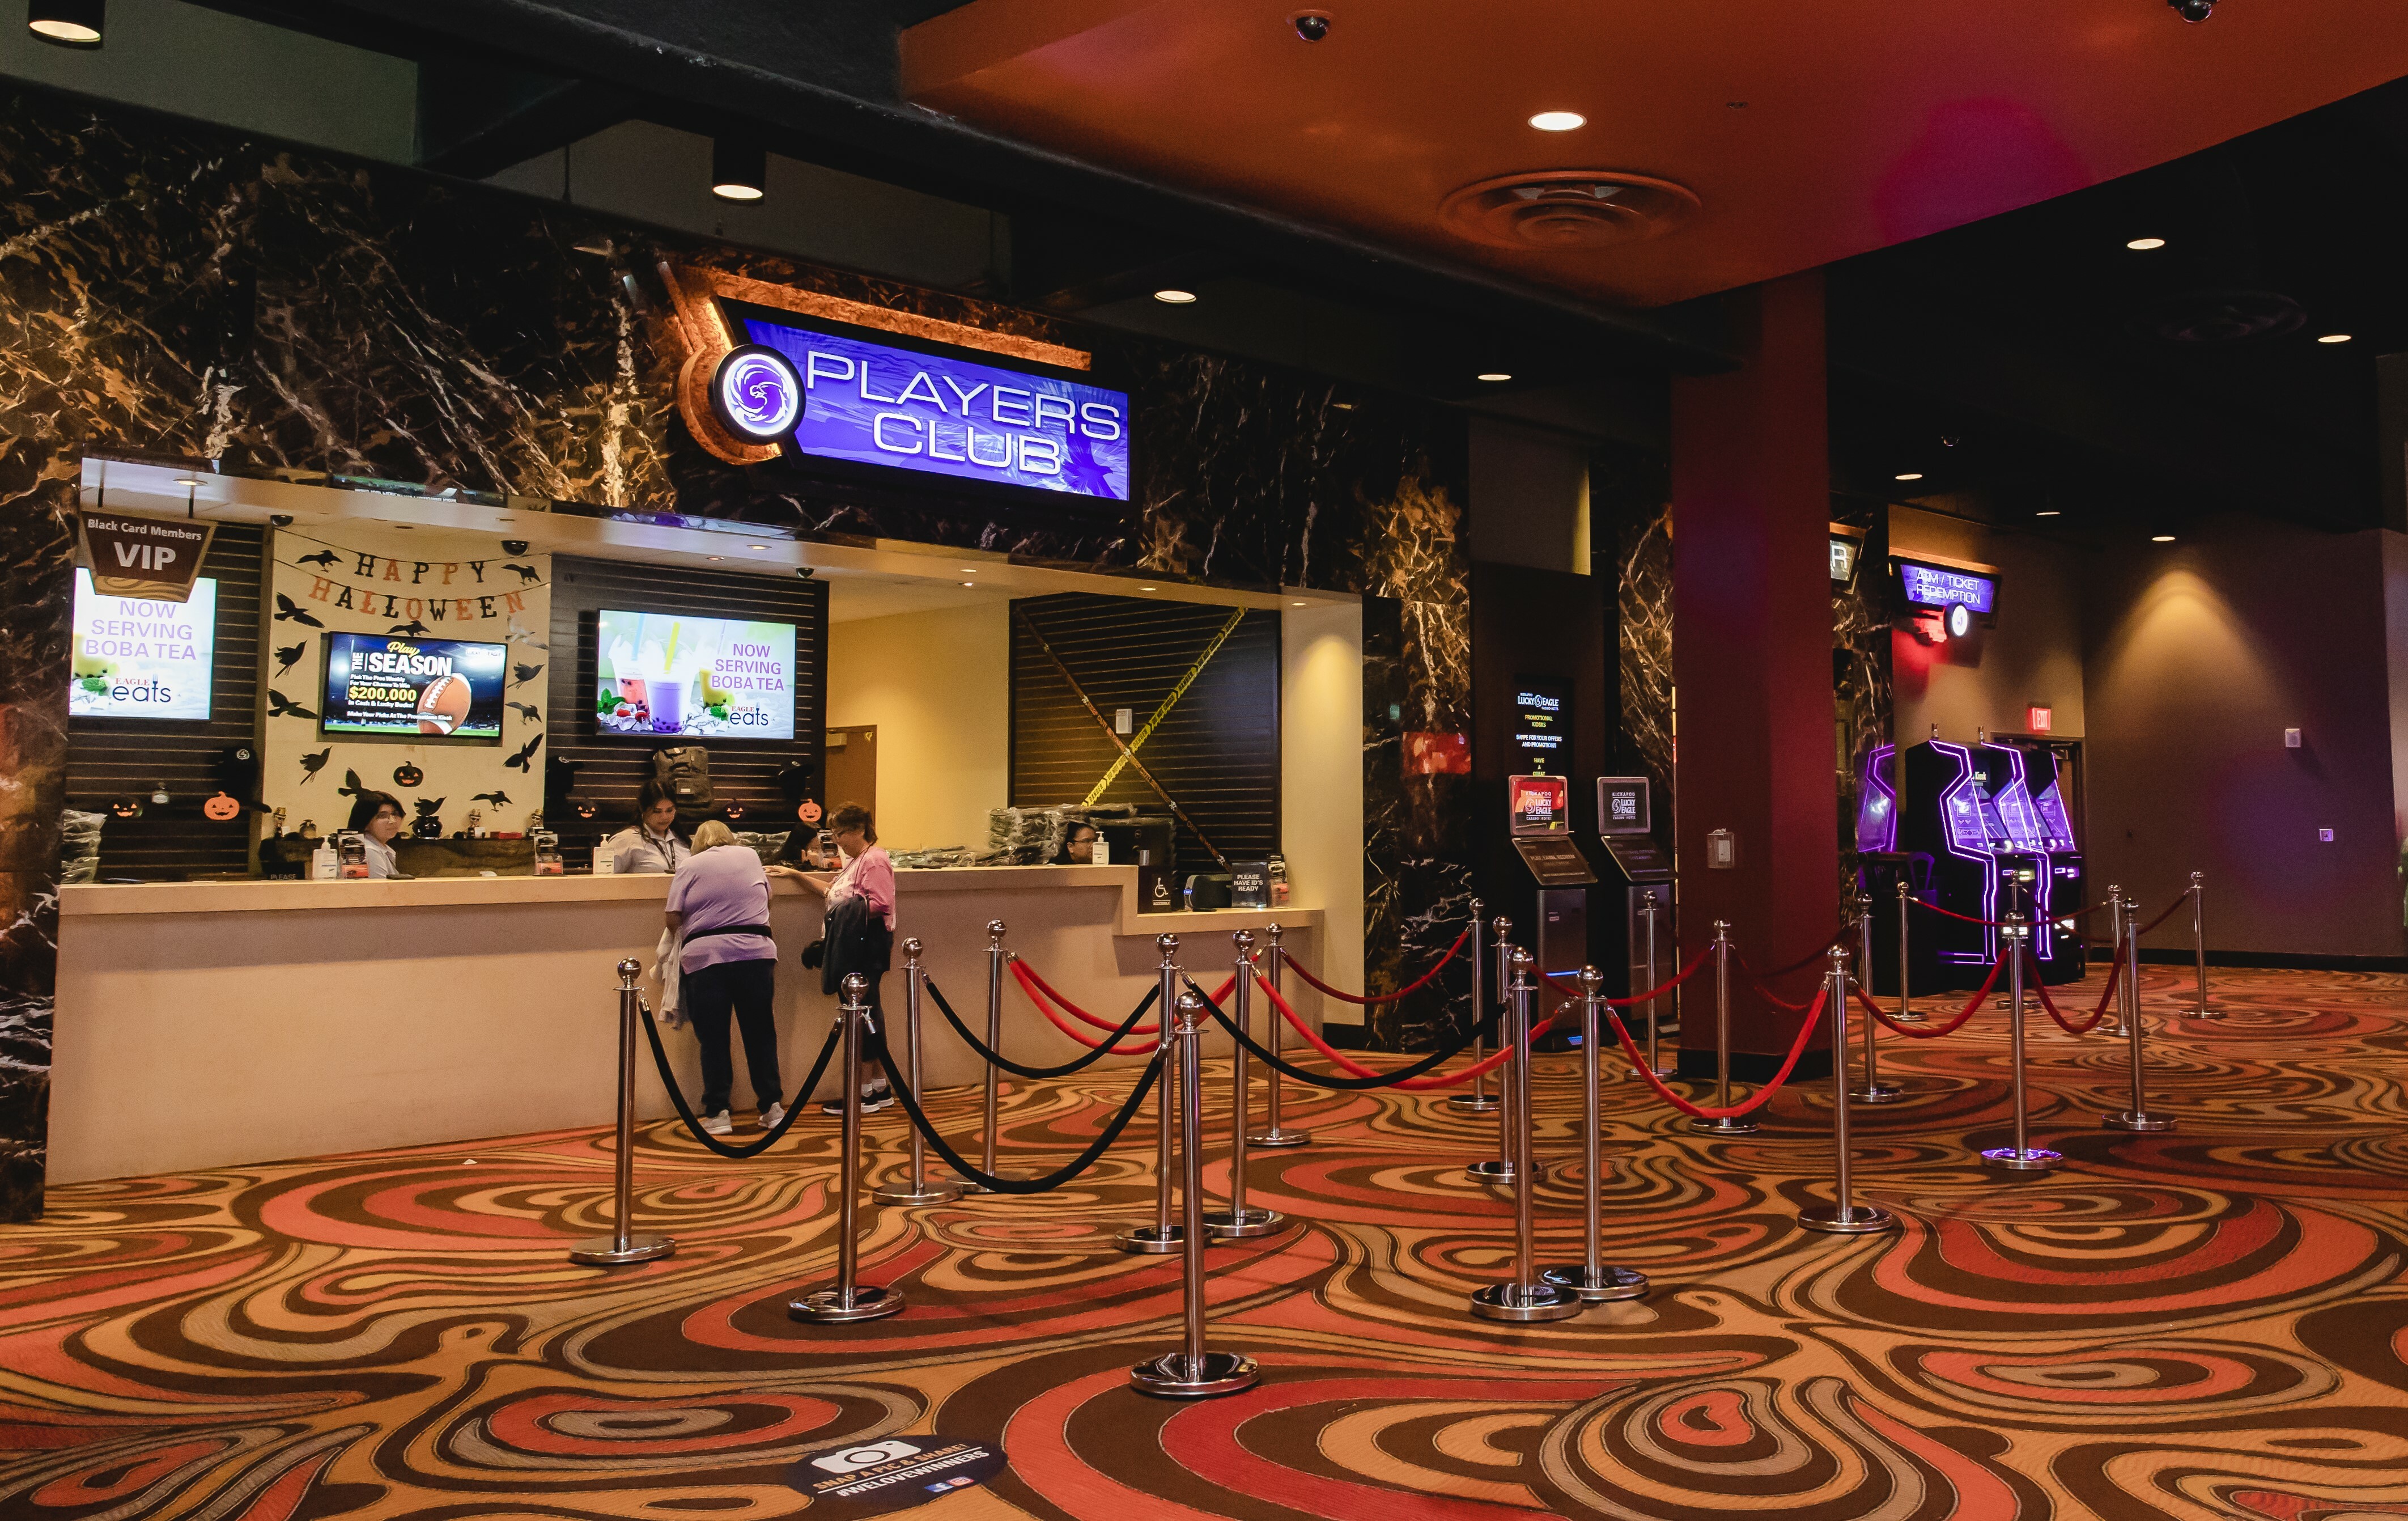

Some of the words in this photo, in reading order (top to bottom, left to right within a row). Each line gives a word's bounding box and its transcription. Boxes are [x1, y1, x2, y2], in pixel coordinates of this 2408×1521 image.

[806, 350, 1121, 441] PLAYERS
[873, 412, 1061, 475] CLUB
[88, 519, 117, 531] Black
[121, 523, 147, 534] Card
[151, 526, 202, 541] Members
[114, 541, 176, 571] VIP
[355, 552, 485, 584] HAPPY
[1917, 568, 1939, 584] ATM
[1947, 575, 1980, 591] TICKET
[309, 576, 525, 621] HALLOWEEN
[1917, 584, 1981, 604] REDEMPTION
[120, 600, 176, 618] NOW
[91, 619, 193, 640] SERVING
[86, 639, 149, 658] BOBA
[154, 643, 197, 660] TEA
[387, 641, 420, 658] Play
[733, 644, 770, 657] NOW
[351, 652, 364, 671] THE
[368, 653, 452, 676] SEASON
[715, 659, 781, 675] SERVING
[112, 677, 171, 702] eats
[116, 677, 150, 686] EAGLE
[712, 675, 753, 689] BOBA
[757, 678, 784, 690] TEA
[349, 685, 417, 702] $200,000
[1518, 696, 1535, 705] LUCKY
[1542, 697, 1559, 706] EAGLE
[730, 706, 768, 726] eats
[2037, 710, 2047, 727] EXIT
[1535, 798, 1552, 807] LUCKY
[813, 1474, 856, 1490] SNAP
[859, 1469, 875, 1477] A
[876, 1463, 901, 1473] PIC
[915, 1443, 970, 1461] SHARE!
[836, 1450, 990, 1497] #WELOVEWINNERS
